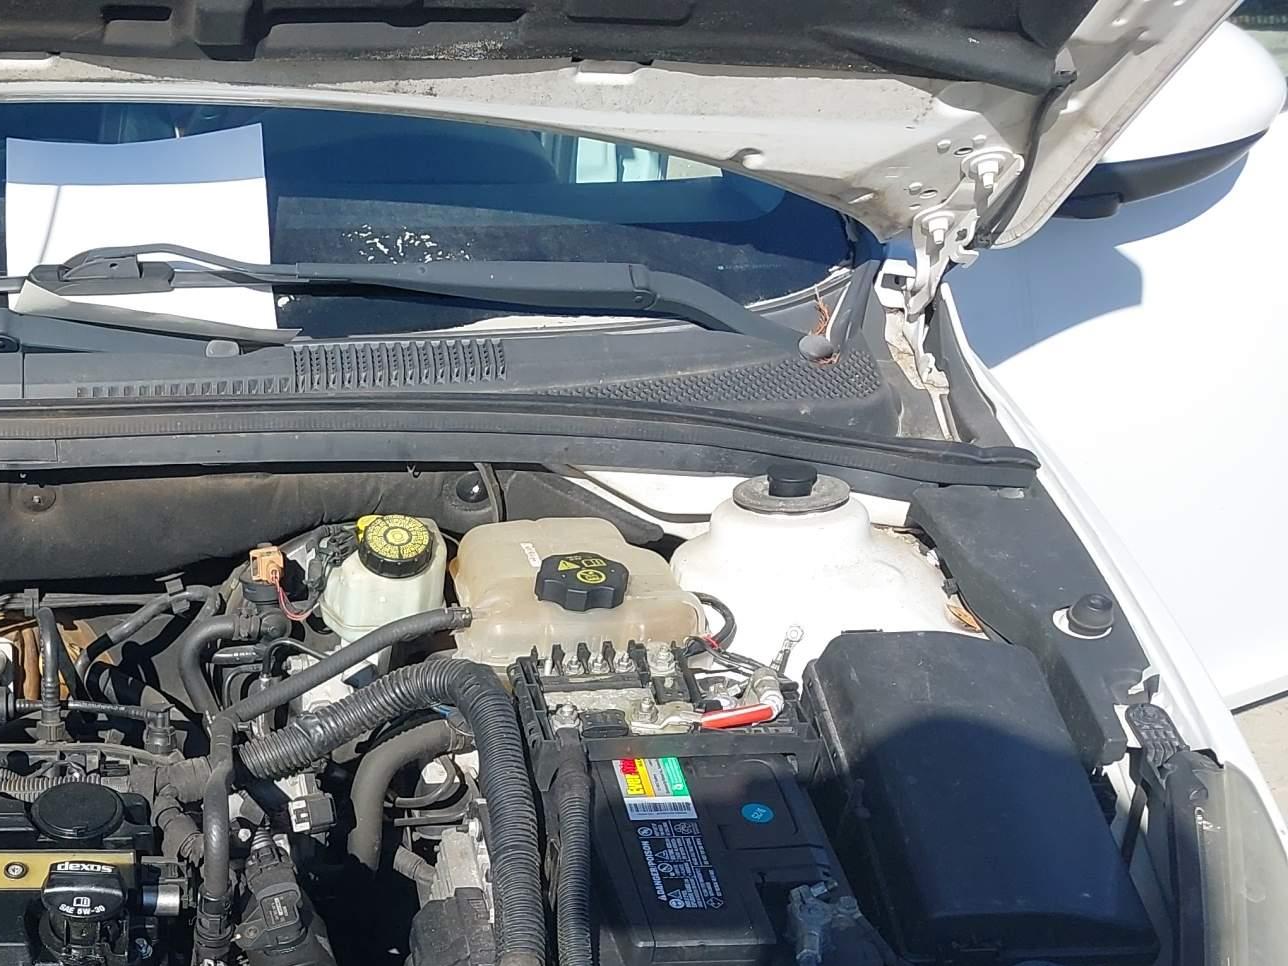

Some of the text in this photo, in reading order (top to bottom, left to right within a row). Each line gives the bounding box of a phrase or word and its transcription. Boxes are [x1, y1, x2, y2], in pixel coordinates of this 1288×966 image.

[57, 862, 116, 873] dexos
[641, 840, 665, 896] DANGER/POISON
[59, 904, 75, 914] SAE
